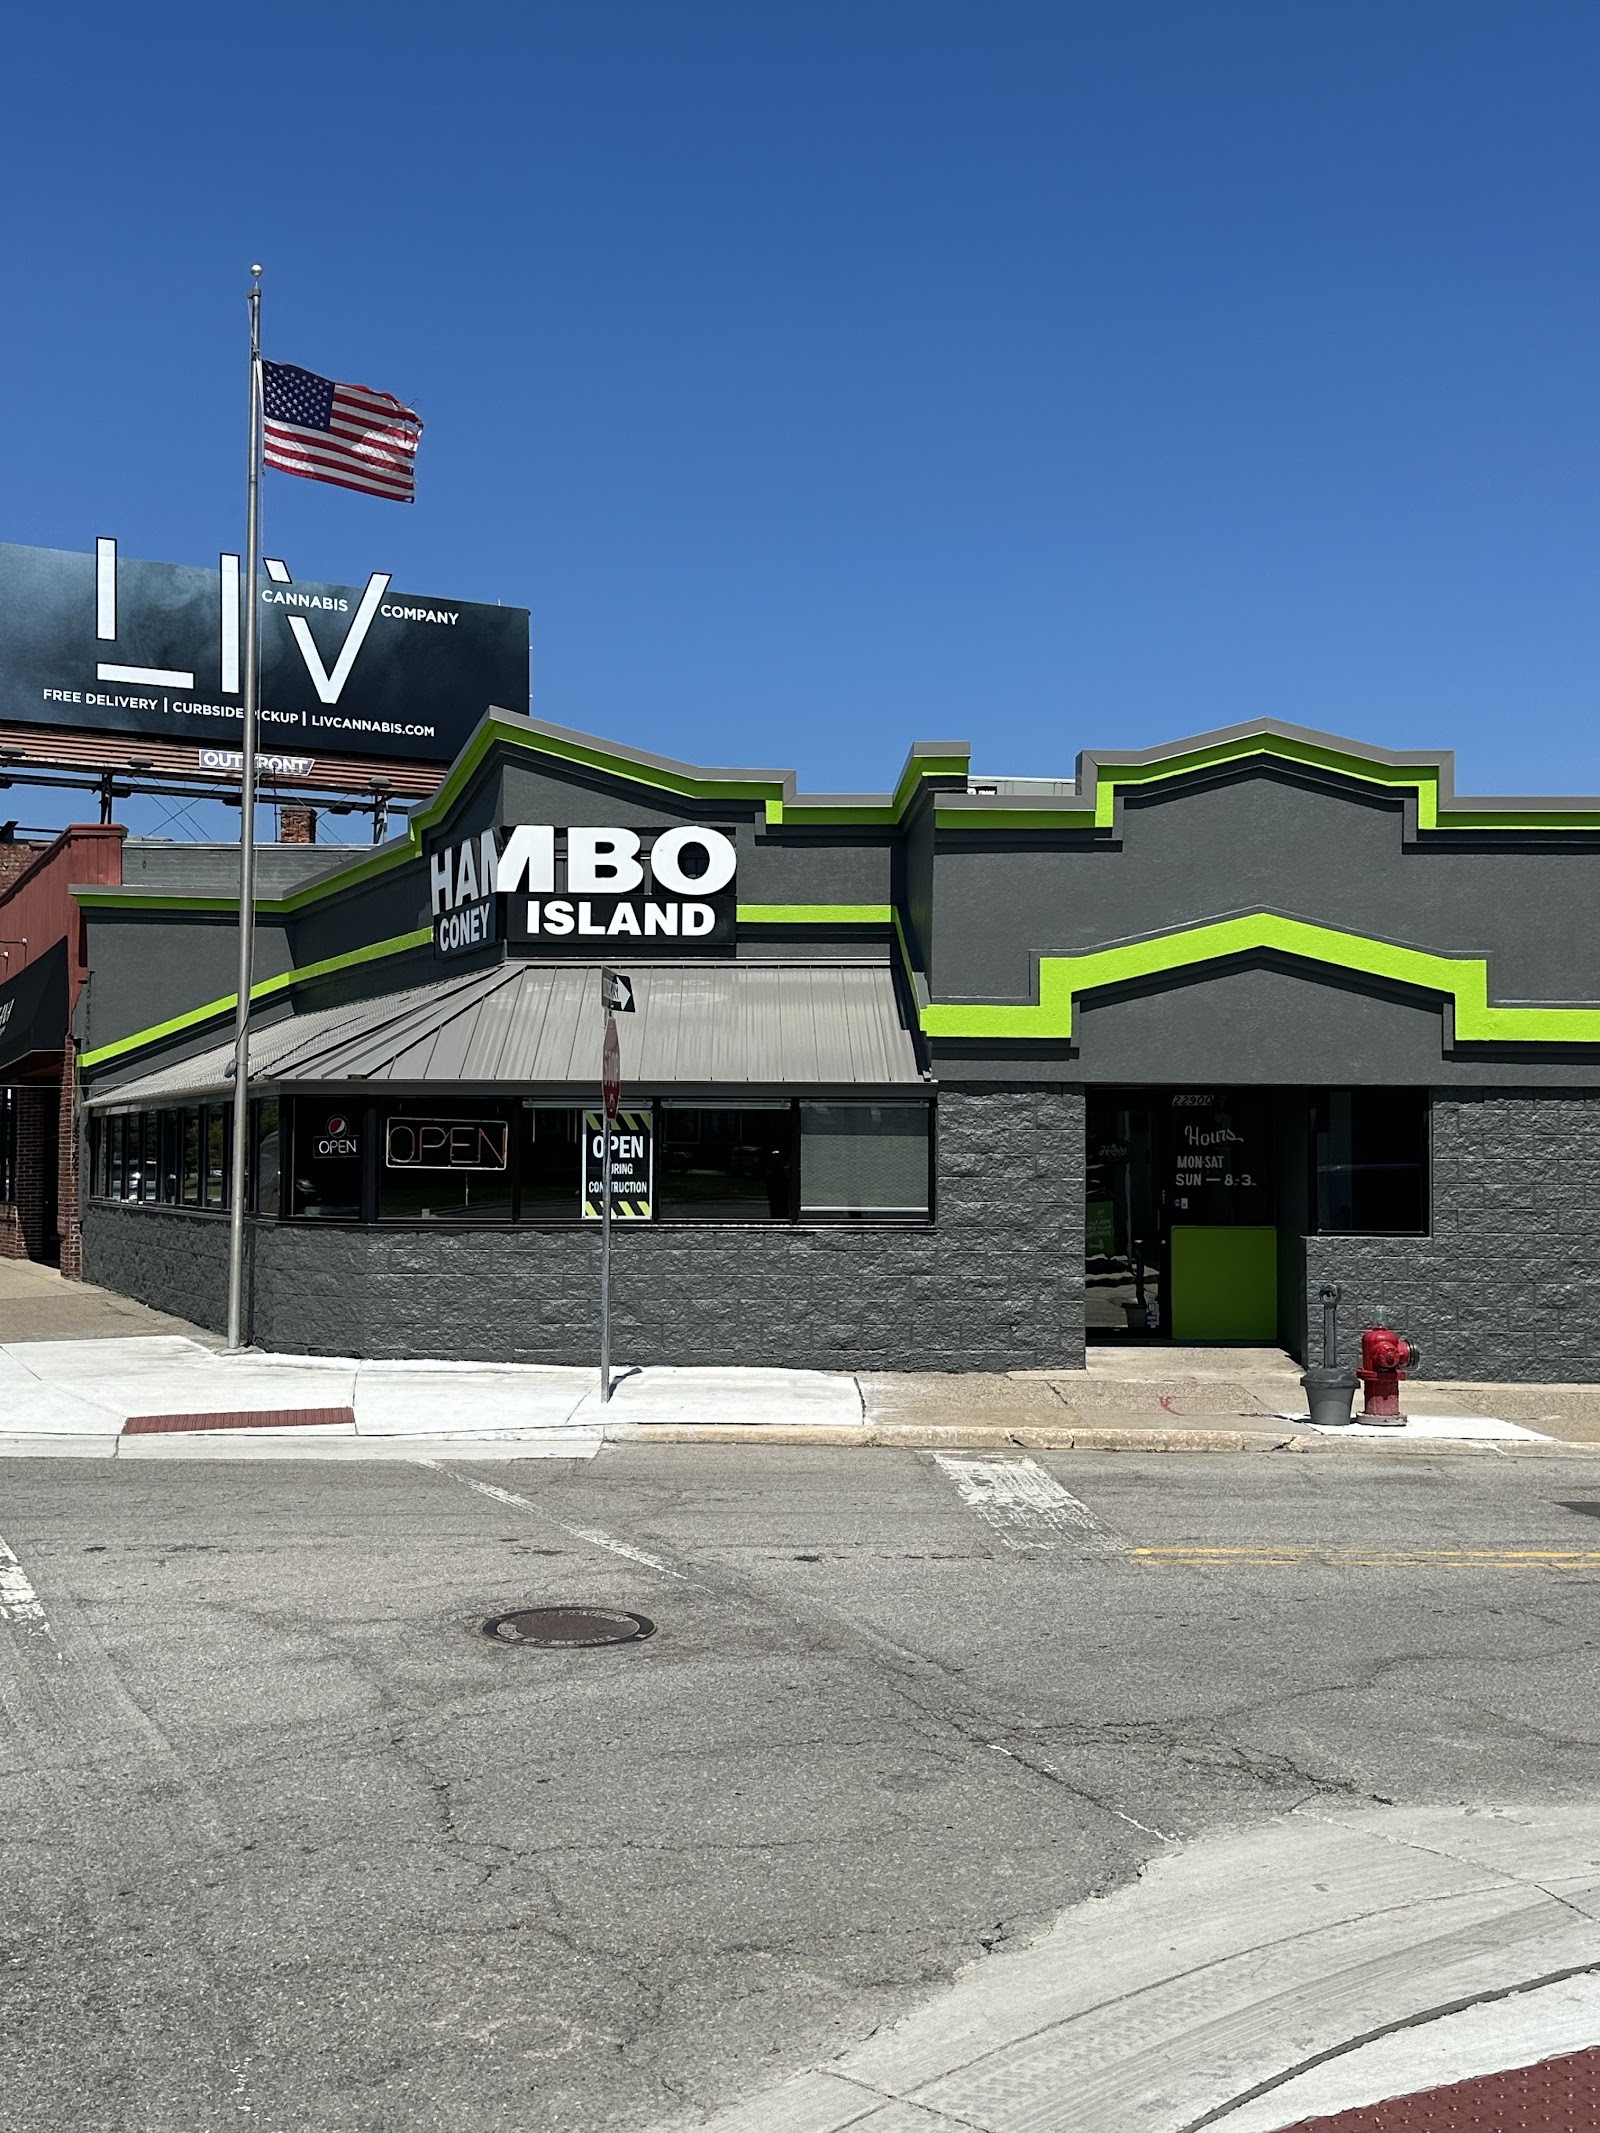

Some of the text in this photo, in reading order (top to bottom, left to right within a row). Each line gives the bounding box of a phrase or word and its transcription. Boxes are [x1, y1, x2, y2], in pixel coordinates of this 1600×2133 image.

[261, 589, 460, 627] CANNABIS COMPANY
[96, 536, 393, 705] LIV
[43, 688, 436, 738] FREE DELIVERY CURBSIDE ICKUP LIVCANNABIS.COM
[203, 751, 309, 774] OUTRONT
[439, 900, 716, 953] CONEY ISLAND
[1173, 1095, 1213, 1106] 22900
[318, 1139, 357, 1155] OPEN
[388, 1125, 507, 1164] OPEN
[593, 1136, 643, 1158] OPEN
[1184, 1125, 1245, 1147] Hours
[1176, 1155, 1225, 1169] MON-SAT
[589, 1182, 647, 1193] CONTRUCTION
[1175, 1173, 1202, 1187] SUN
